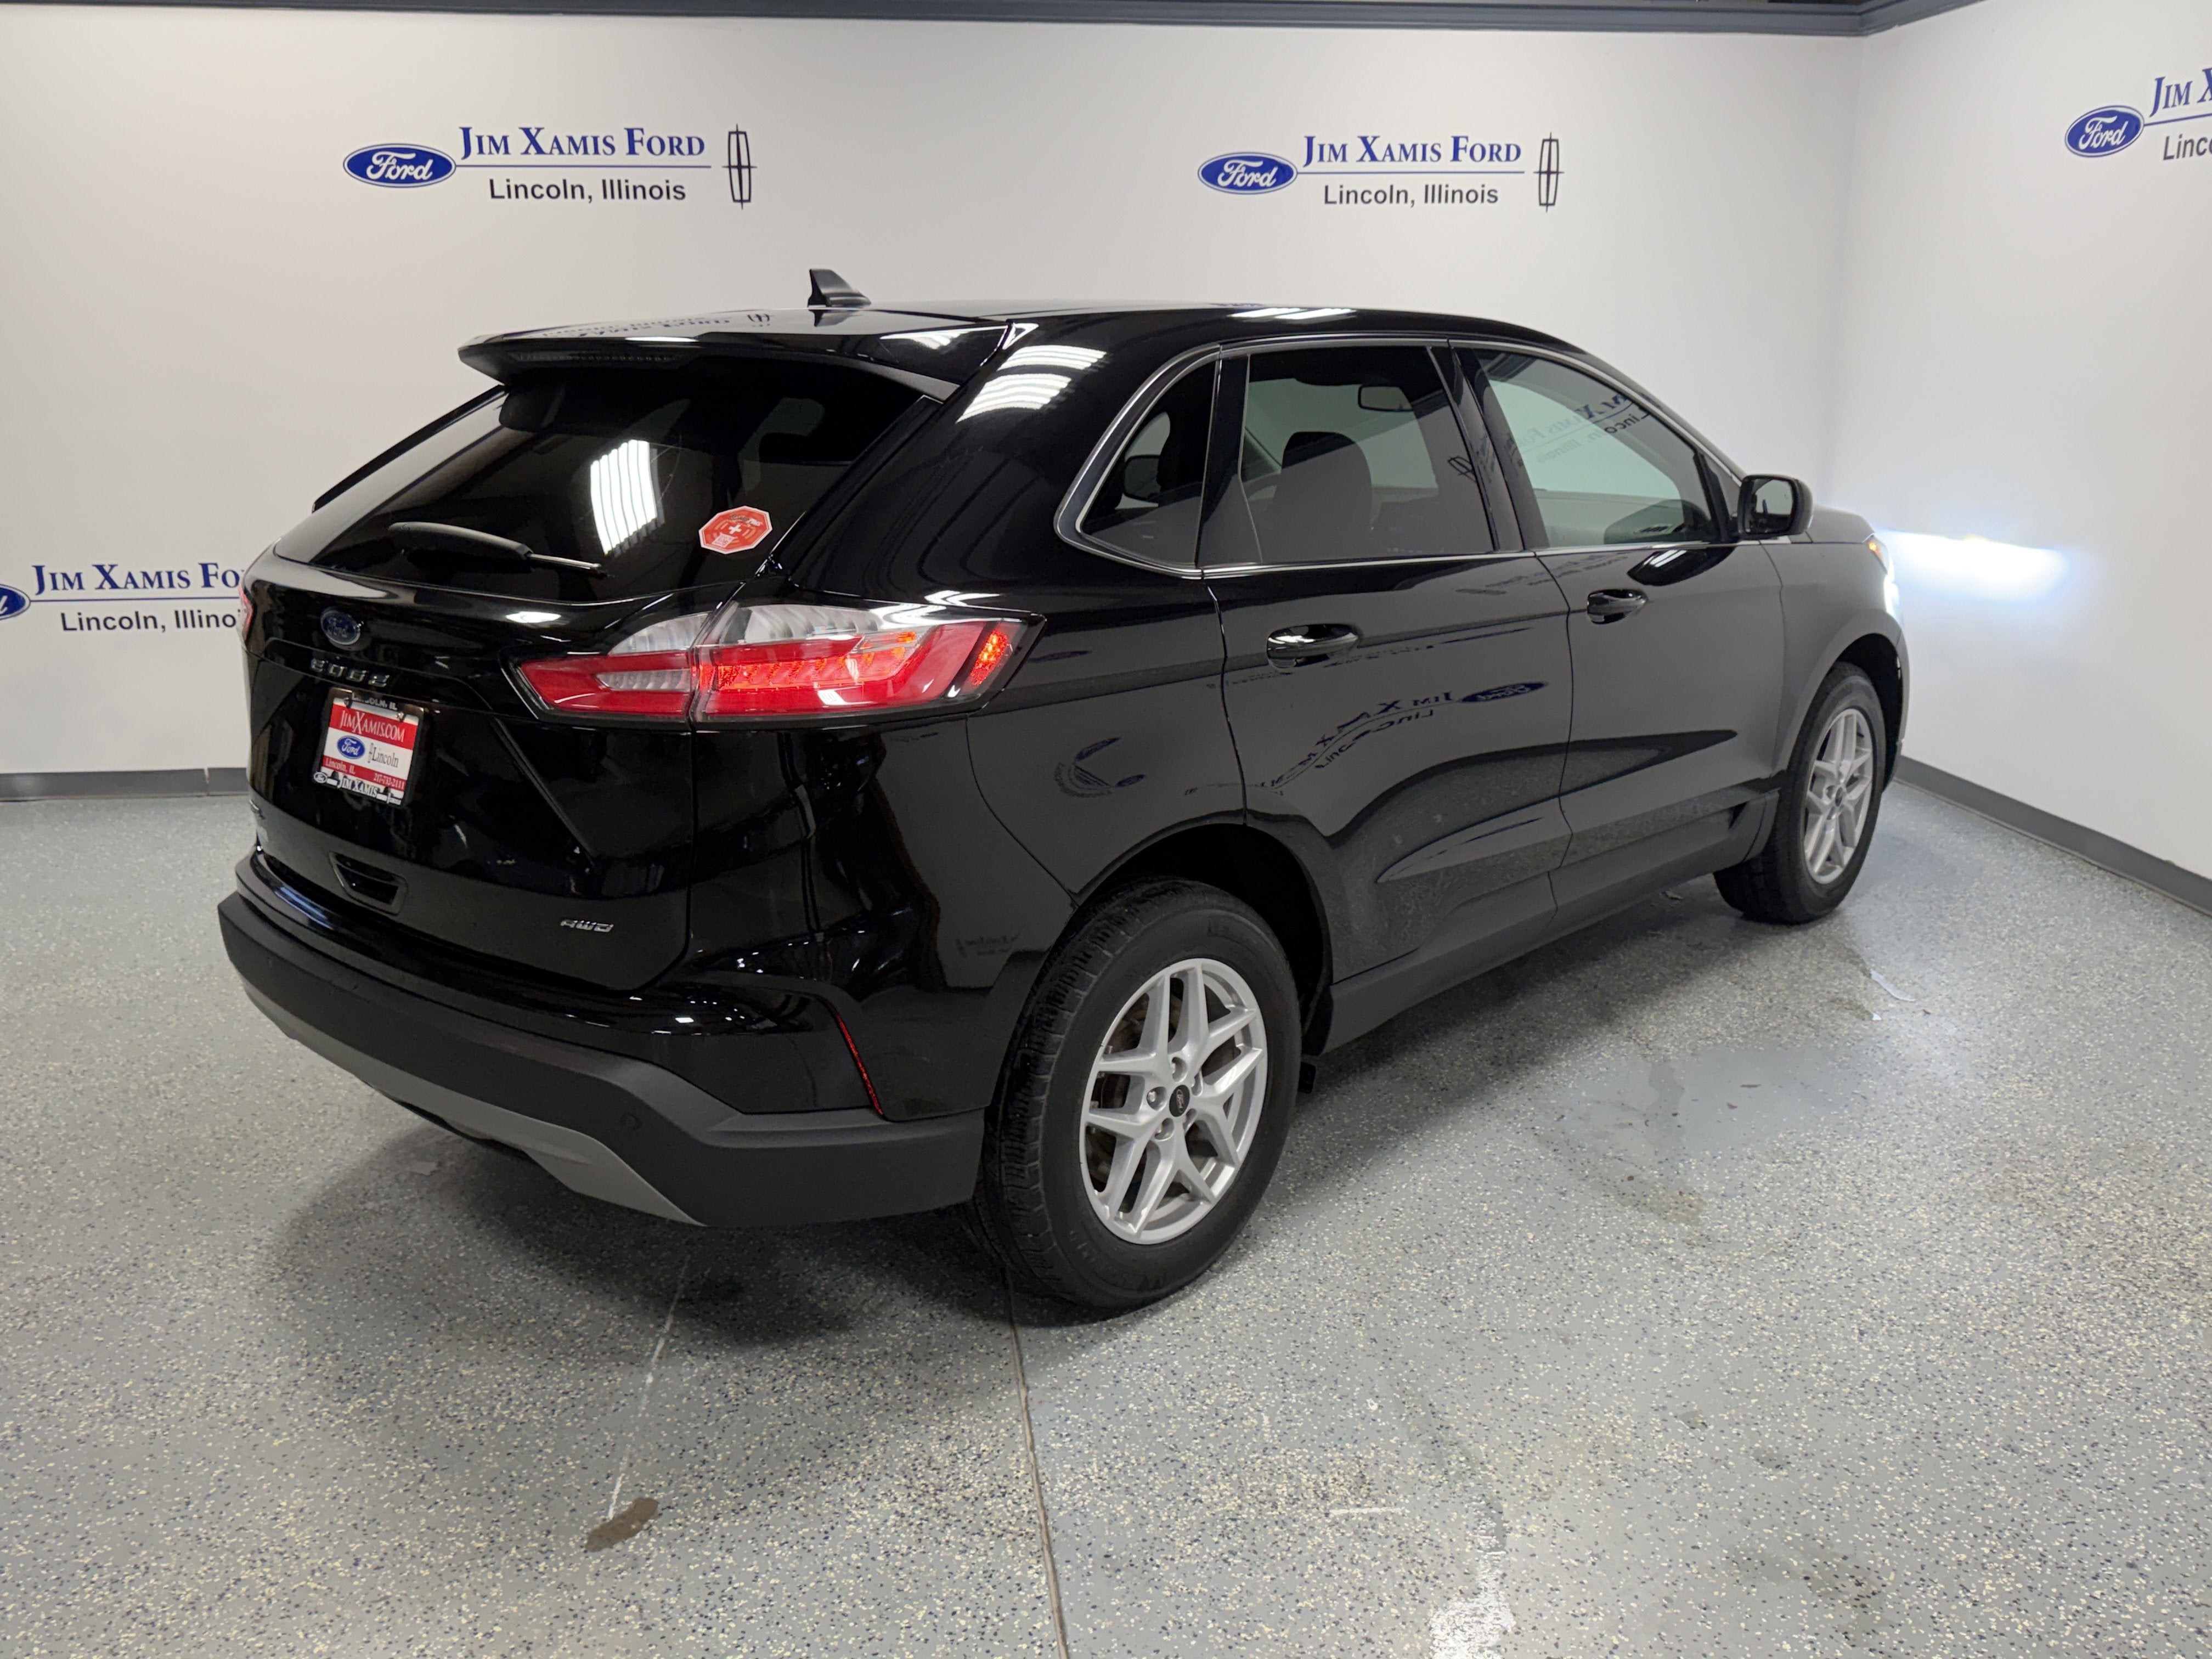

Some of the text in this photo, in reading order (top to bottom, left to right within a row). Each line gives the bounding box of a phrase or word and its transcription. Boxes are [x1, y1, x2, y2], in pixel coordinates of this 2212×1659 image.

[459, 127, 706, 160] JIM XAMIS FORD
[2078, 115, 2129, 150] Ford
[1303, 136, 1521, 168] JIM XAMIS FORD
[2163, 133, 2212, 161] Linc
[366, 150, 433, 182] Ford
[1217, 160, 1277, 188] Ford
[490, 178, 686, 204] Lincoln, Illinois
[1324, 184, 1499, 207] Lincoln, Illinois
[32, 562, 245, 596] JIM XAMIS FO
[61, 608, 241, 632] Lincoln, Illino
[341, 738, 362, 756] Ford
[371, 747, 399, 768] Lincoln
